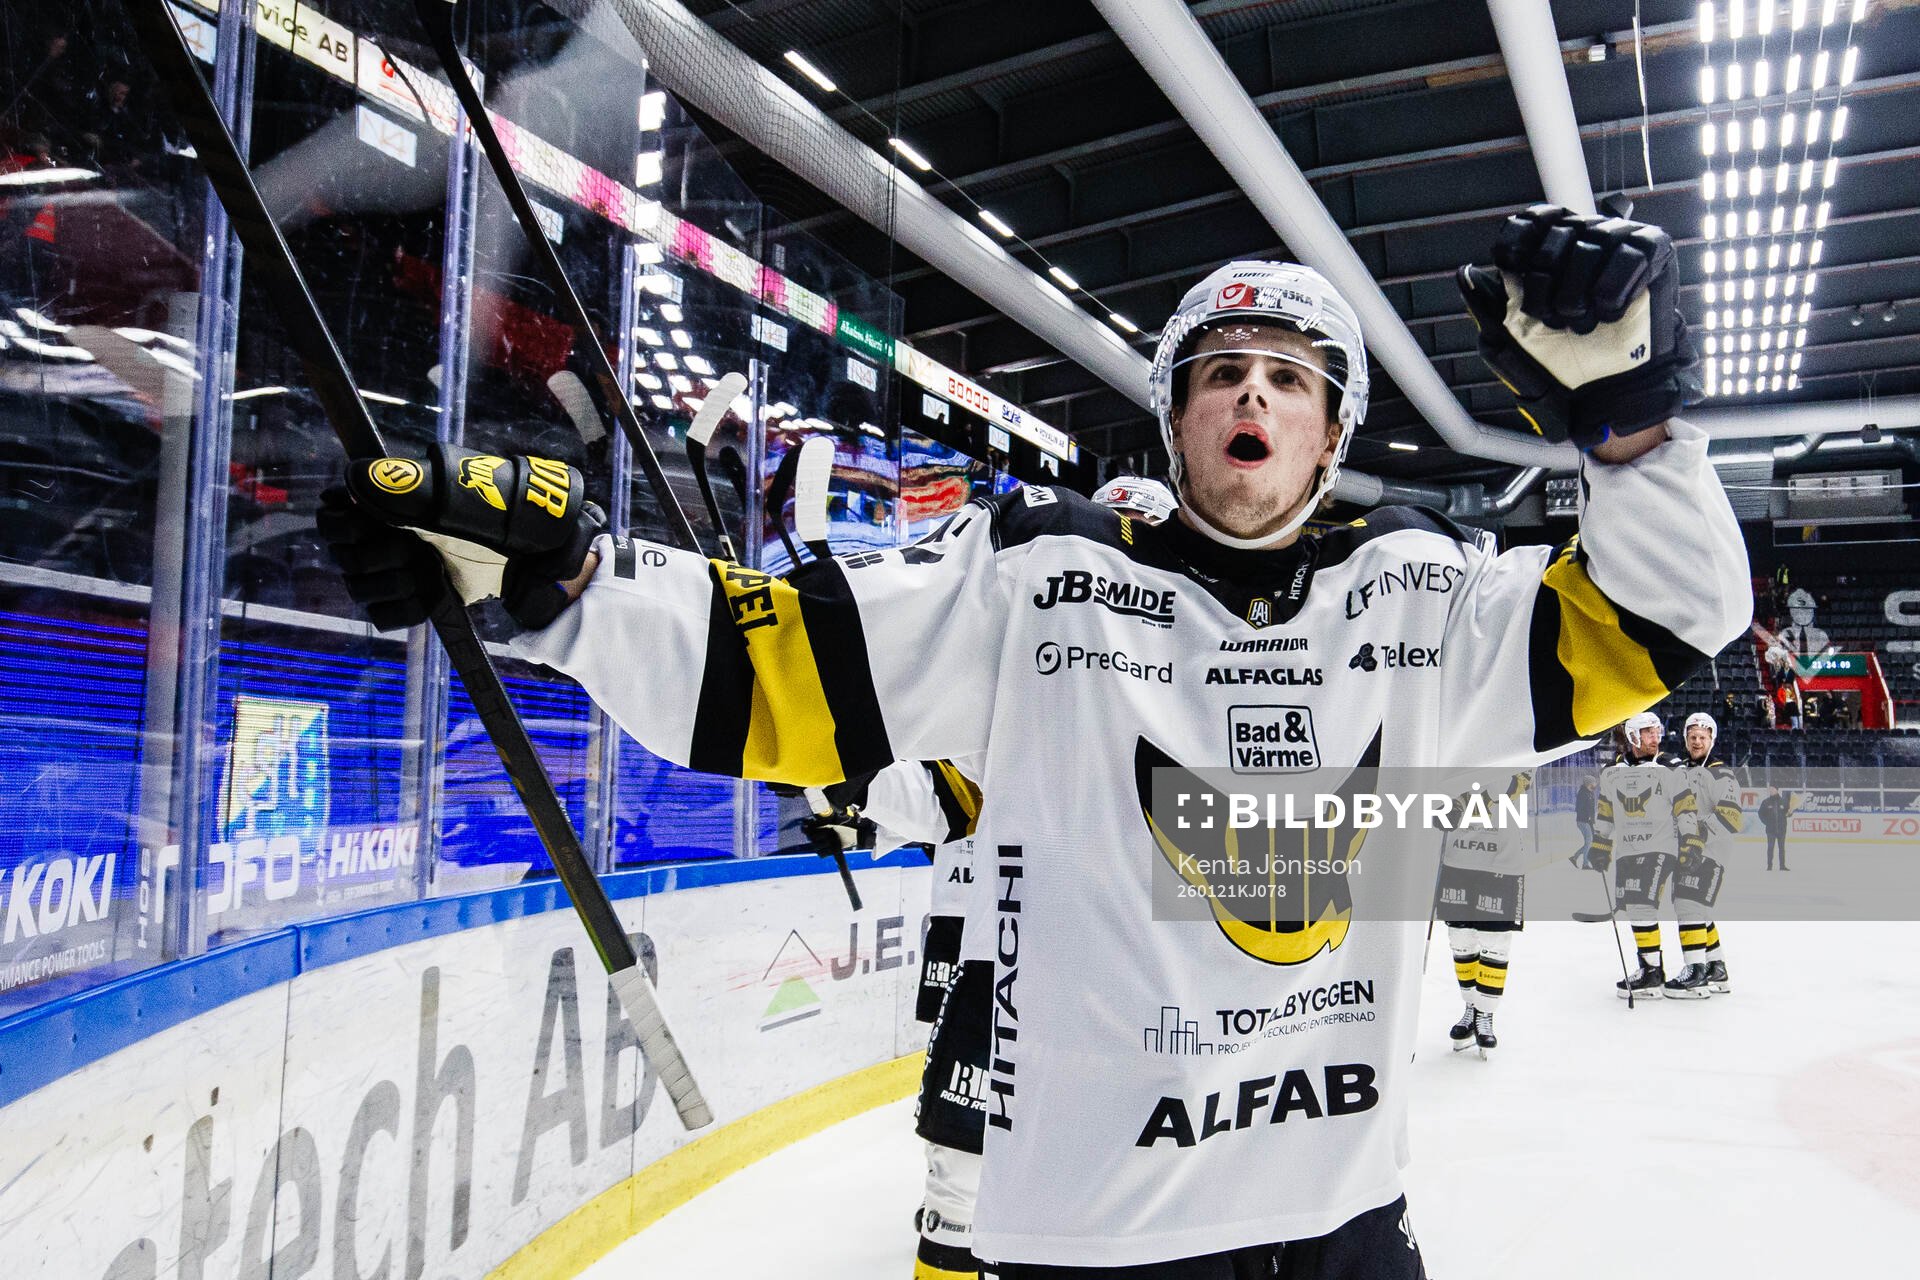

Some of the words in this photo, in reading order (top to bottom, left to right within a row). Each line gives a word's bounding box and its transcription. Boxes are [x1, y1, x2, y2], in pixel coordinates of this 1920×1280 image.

[257, 2, 308, 42] vice
[319, 33, 348, 62] AB
[1033, 570, 1094, 610] JB
[1094, 576, 1177, 614] SMIDE
[1288, 562, 1310, 600] HITACH
[1346, 579, 1376, 620] LF
[1379, 562, 1464, 596] INVEST
[1219, 638, 1309, 653] WARRIOR
[1381, 642, 1442, 668] Telex
[1067, 646, 1173, 684] PreGard
[1205, 667, 1324, 686] ALFAGLAS
[1235, 721, 1280, 743] Bad
[1284, 711, 1310, 743] &
[1236, 746, 1314, 767] Värme
[1794, 819, 1861, 832] METROLIT
[328, 826, 419, 879] HiKOKI
[1453, 838, 1498, 852] ALFAB
[0, 852, 117, 945] KOKI
[41, 949, 75, 978] POWER
[76, 939, 105, 964] TOOLS
[831, 912, 932, 981] J.E.
[988, 844, 1024, 1133] HITACHI
[511, 932, 658, 1206] AB
[940, 1089, 969, 1106] ROAD
[1135, 1063, 1380, 1148] ALFAB
